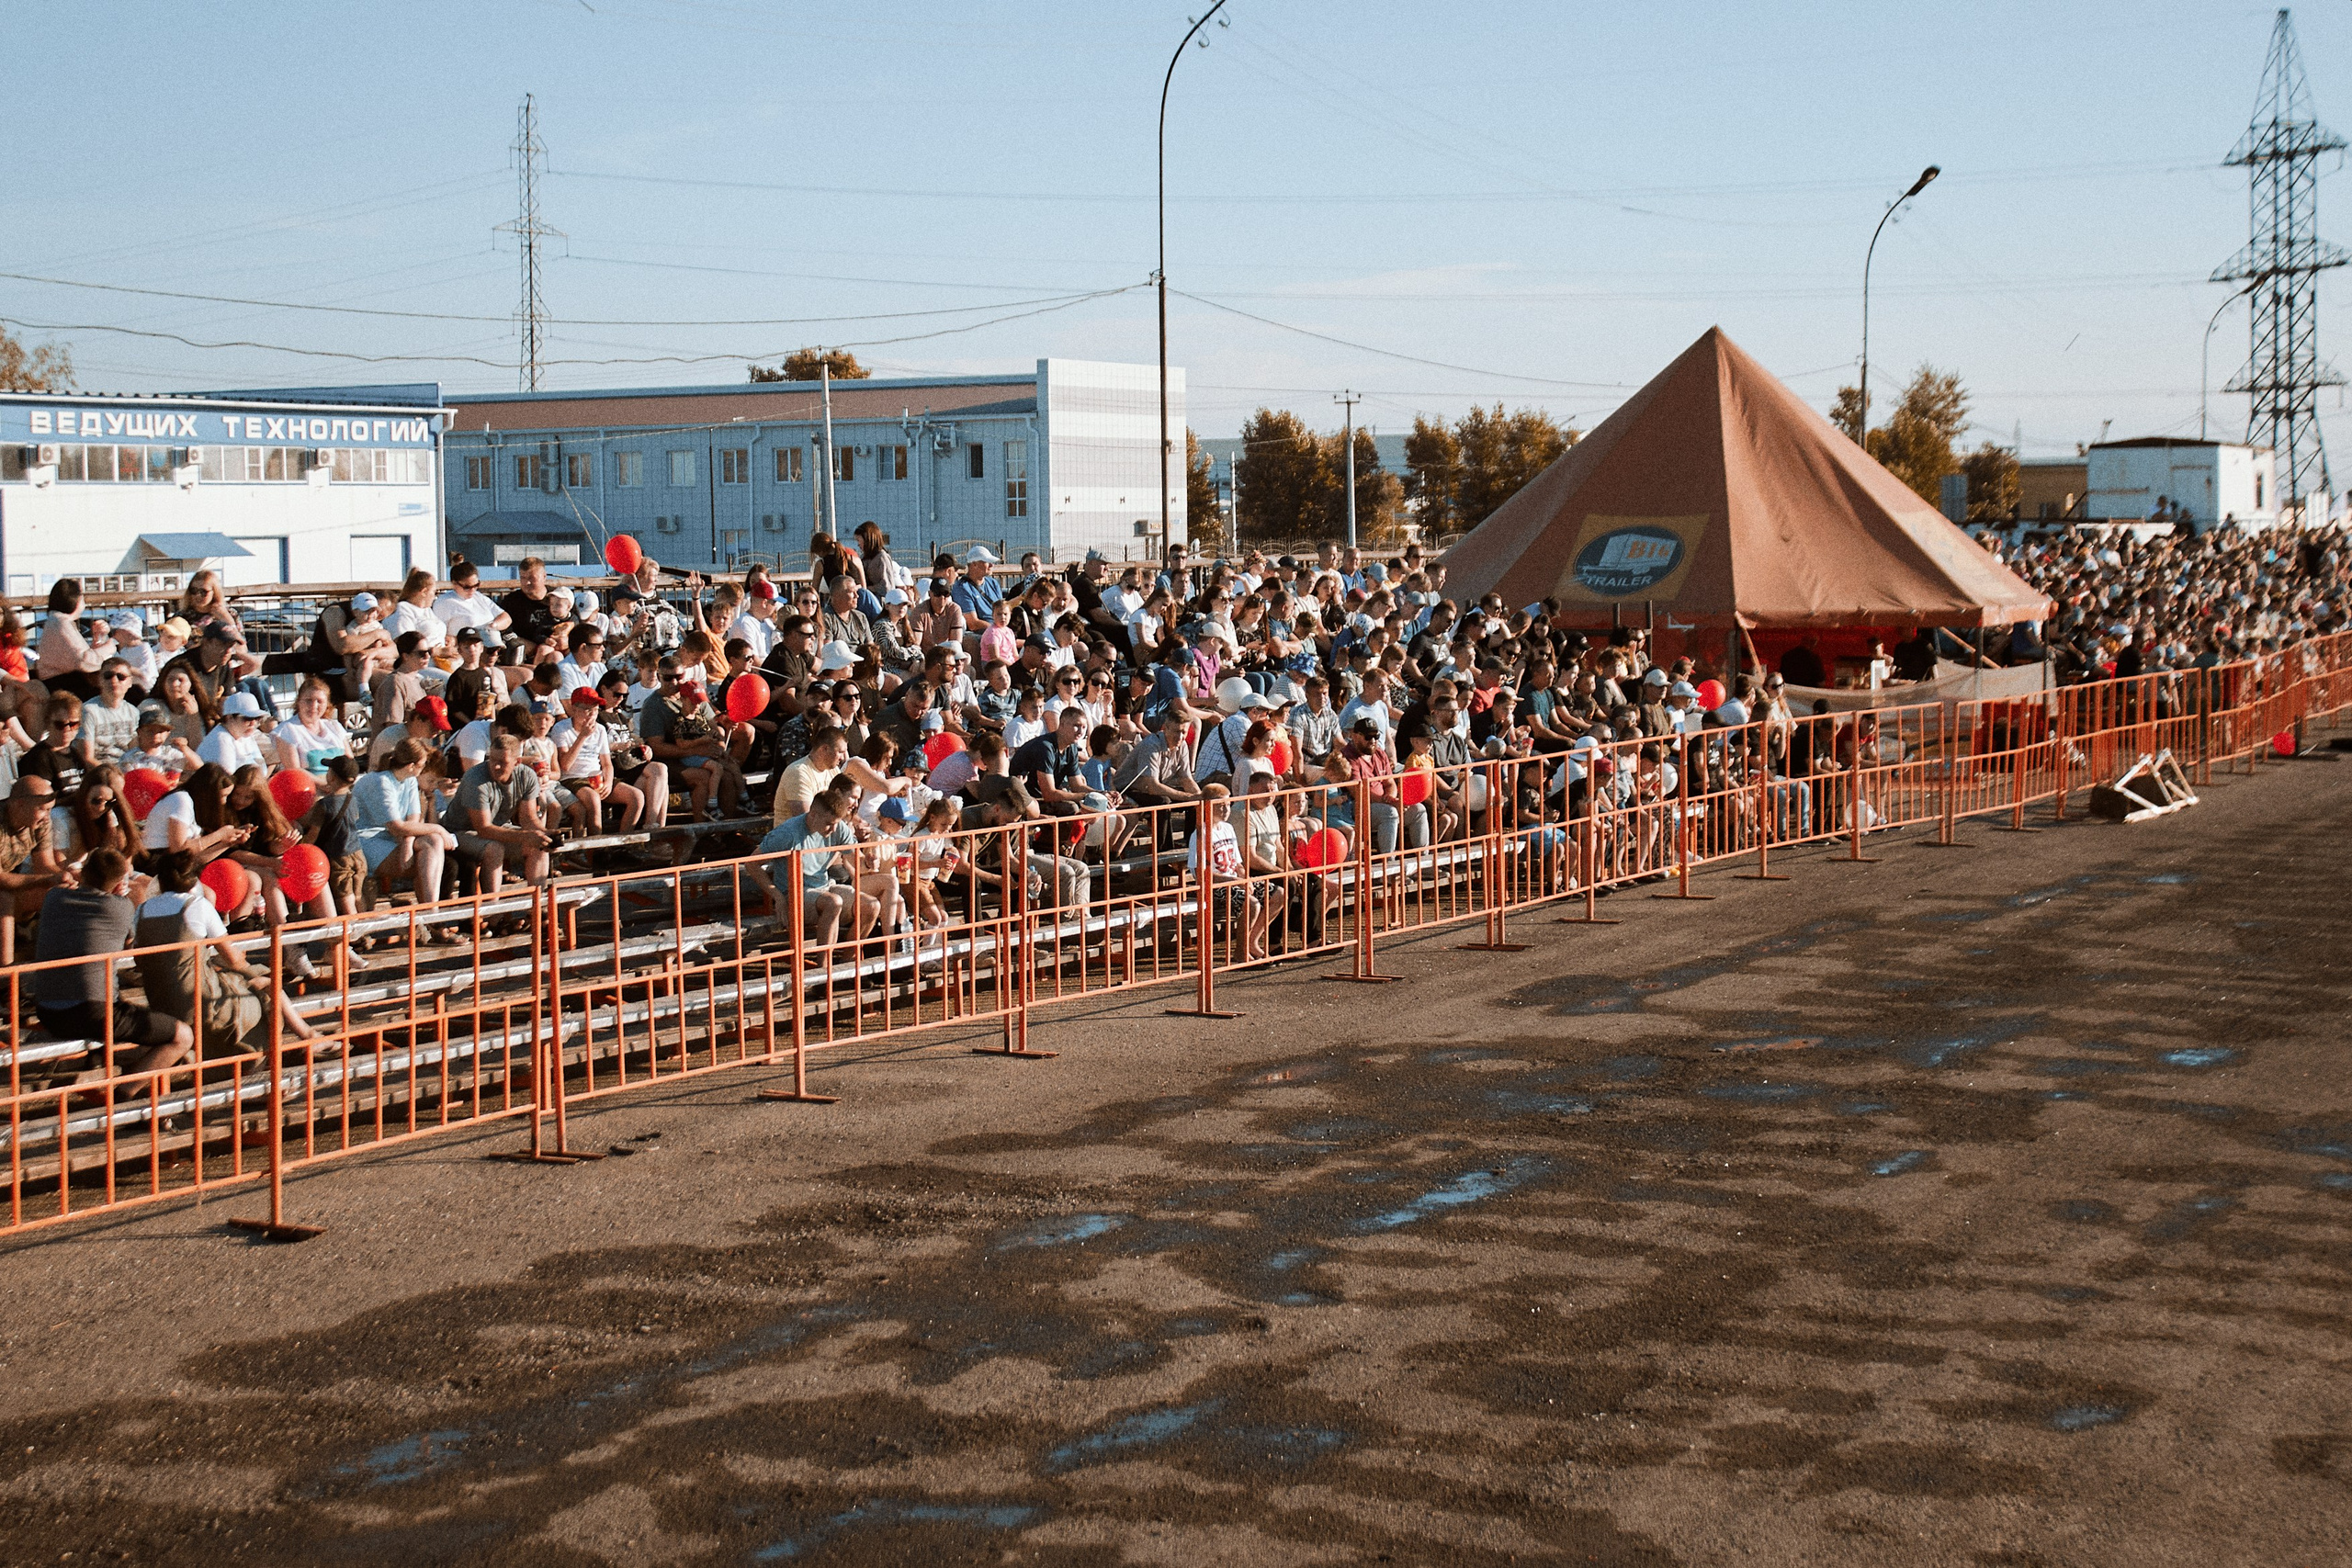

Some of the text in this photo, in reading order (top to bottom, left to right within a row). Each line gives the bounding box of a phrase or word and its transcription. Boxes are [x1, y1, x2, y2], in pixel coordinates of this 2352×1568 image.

[30, 411, 429, 442] ВЕДУЩИХ ТЕХНОЛОГИЙ
[1627, 540, 1670, 558] BIG
[1586, 575, 1654, 586] TRAILER
